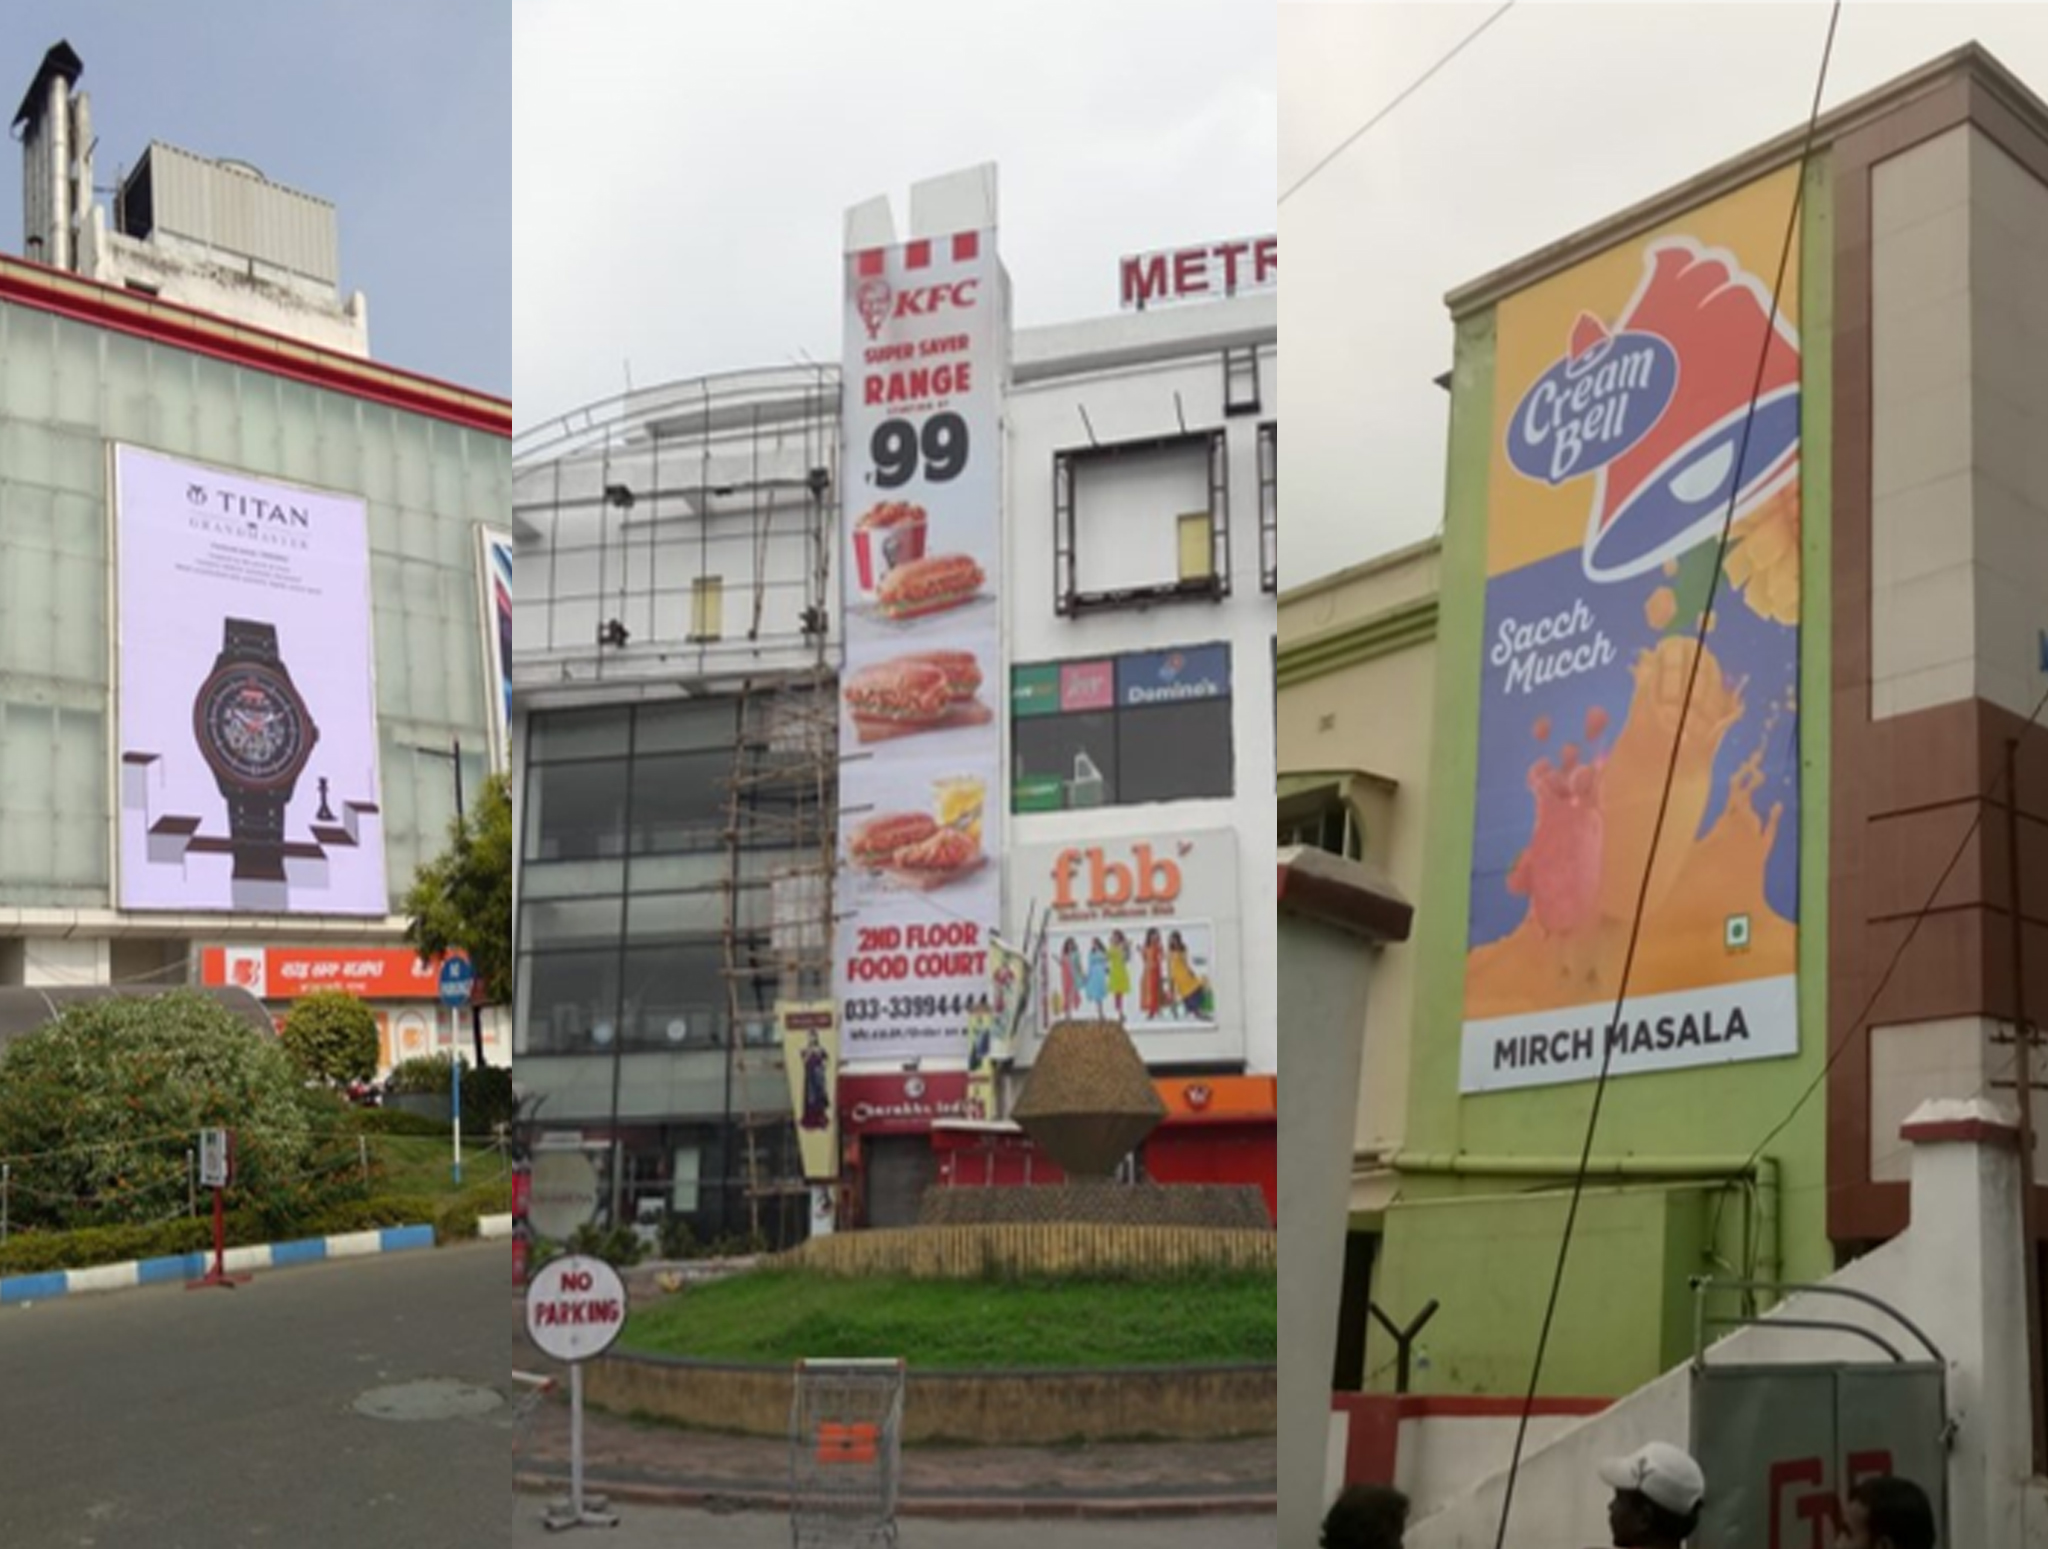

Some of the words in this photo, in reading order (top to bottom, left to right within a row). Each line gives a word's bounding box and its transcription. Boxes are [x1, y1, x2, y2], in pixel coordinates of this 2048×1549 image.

[893, 279, 979, 318] KFC
[864, 342, 915, 364] SUPER
[918, 333, 970, 357] SAVER
[864, 362, 972, 406] RANGE
[1524, 347, 1655, 445] Cream
[1551, 393, 1629, 480] Bell
[216, 490, 309, 528] TITAN
[1490, 598, 1595, 667] Sacch
[1503, 630, 1618, 694] Mucch
[1127, 678, 1217, 704] Domino's
[1051, 843, 1183, 911] fbb
[857, 926, 901, 951] 2ND
[906, 922, 979, 948] FLOOR
[847, 954, 908, 982] FOOD
[914, 952, 988, 978] COURT
[1493, 1027, 1594, 1071] MIRCH
[1604, 1006, 1750, 1057] MASALA
[561, 1271, 594, 1292] NO
[535, 1299, 620, 1327] PARKING
